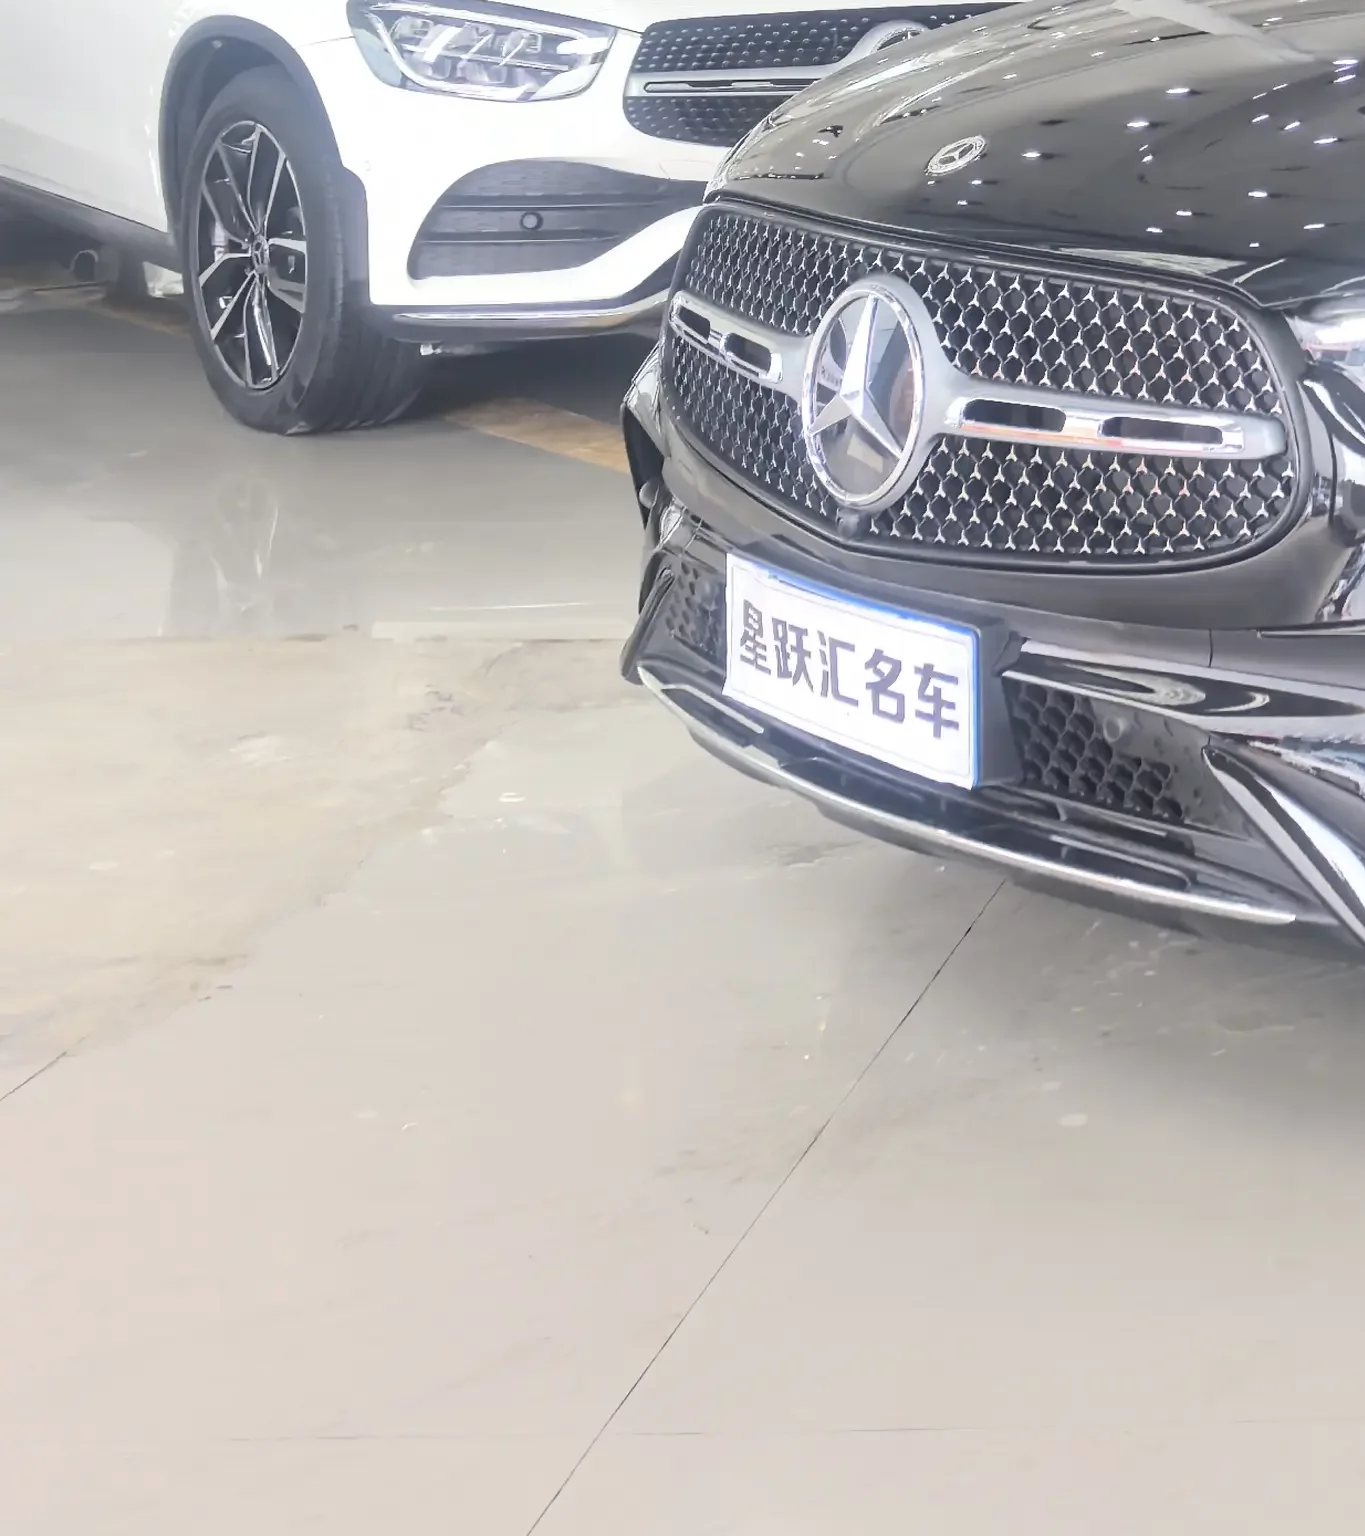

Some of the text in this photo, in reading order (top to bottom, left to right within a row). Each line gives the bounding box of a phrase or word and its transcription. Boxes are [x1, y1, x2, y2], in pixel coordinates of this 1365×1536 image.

[739, 599, 960, 740] 星跃汇名车
